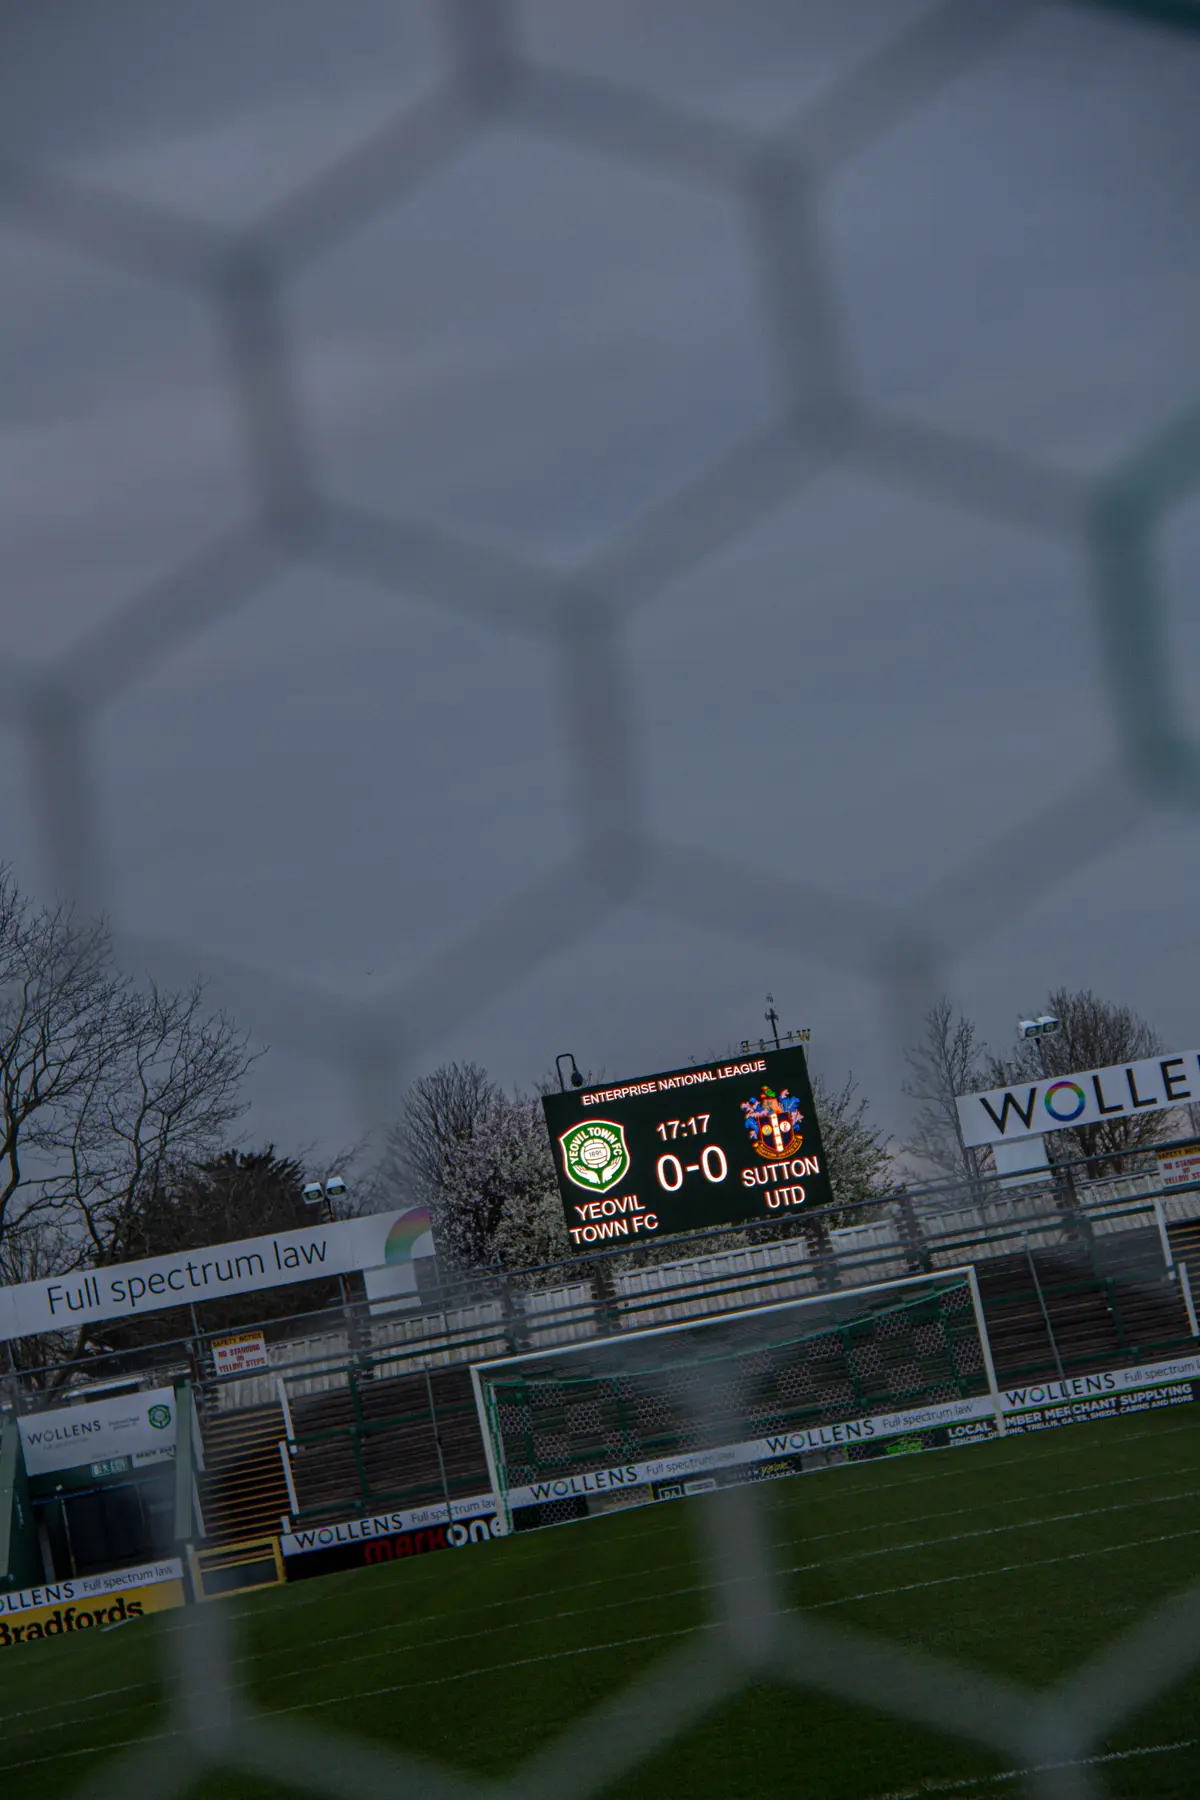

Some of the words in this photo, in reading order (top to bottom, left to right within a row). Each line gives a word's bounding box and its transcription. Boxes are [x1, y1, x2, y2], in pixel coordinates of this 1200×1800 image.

[581, 1081, 657, 1106] ENTERPRISE
[656, 1070, 717, 1092] NATIONAL
[717, 1060, 767, 1080] LEAGUE
[979, 1055, 1200, 1135] WOLLE
[656, 1113, 711, 1142] 17:17
[569, 1130, 590, 1165] YEOVIL
[587, 1126, 619, 1145] TOWN
[611, 1142, 624, 1156] FC
[656, 1145, 729, 1192] 0-0
[741, 1154, 820, 1187] SUTTON
[573, 1194, 647, 1221] YEOVIL
[764, 1184, 806, 1208] UTD
[569, 1218, 630, 1244] TOWN
[631, 1212, 660, 1233] FC
[47, 1276, 100, 1315] Full
[110, 1253, 265, 1308] spectrum
[273, 1240, 326, 1270] law
[1005, 1373, 1116, 1406] WOLLENS
[1124, 1371, 1143, 1383] Full
[1144, 1362, 1195, 1380] spectrum
[947, 1421, 993, 1439] LOCAL
[1044, 1397, 1118, 1420] MERCHANT
[1119, 1383, 1193, 1407] SUPPLYING
[27, 1420, 101, 1445] WOLLENS
[766, 1419, 875, 1453] WOLLENS
[529, 1466, 638, 1500] WOLLENS
[294, 1514, 404, 1549] WOLLENS
[411, 1510, 429, 1523] Full
[82, 1578, 102, 1592] Full
[103, 1570, 155, 1590] spectrum
[154, 1566, 174, 1578] law
